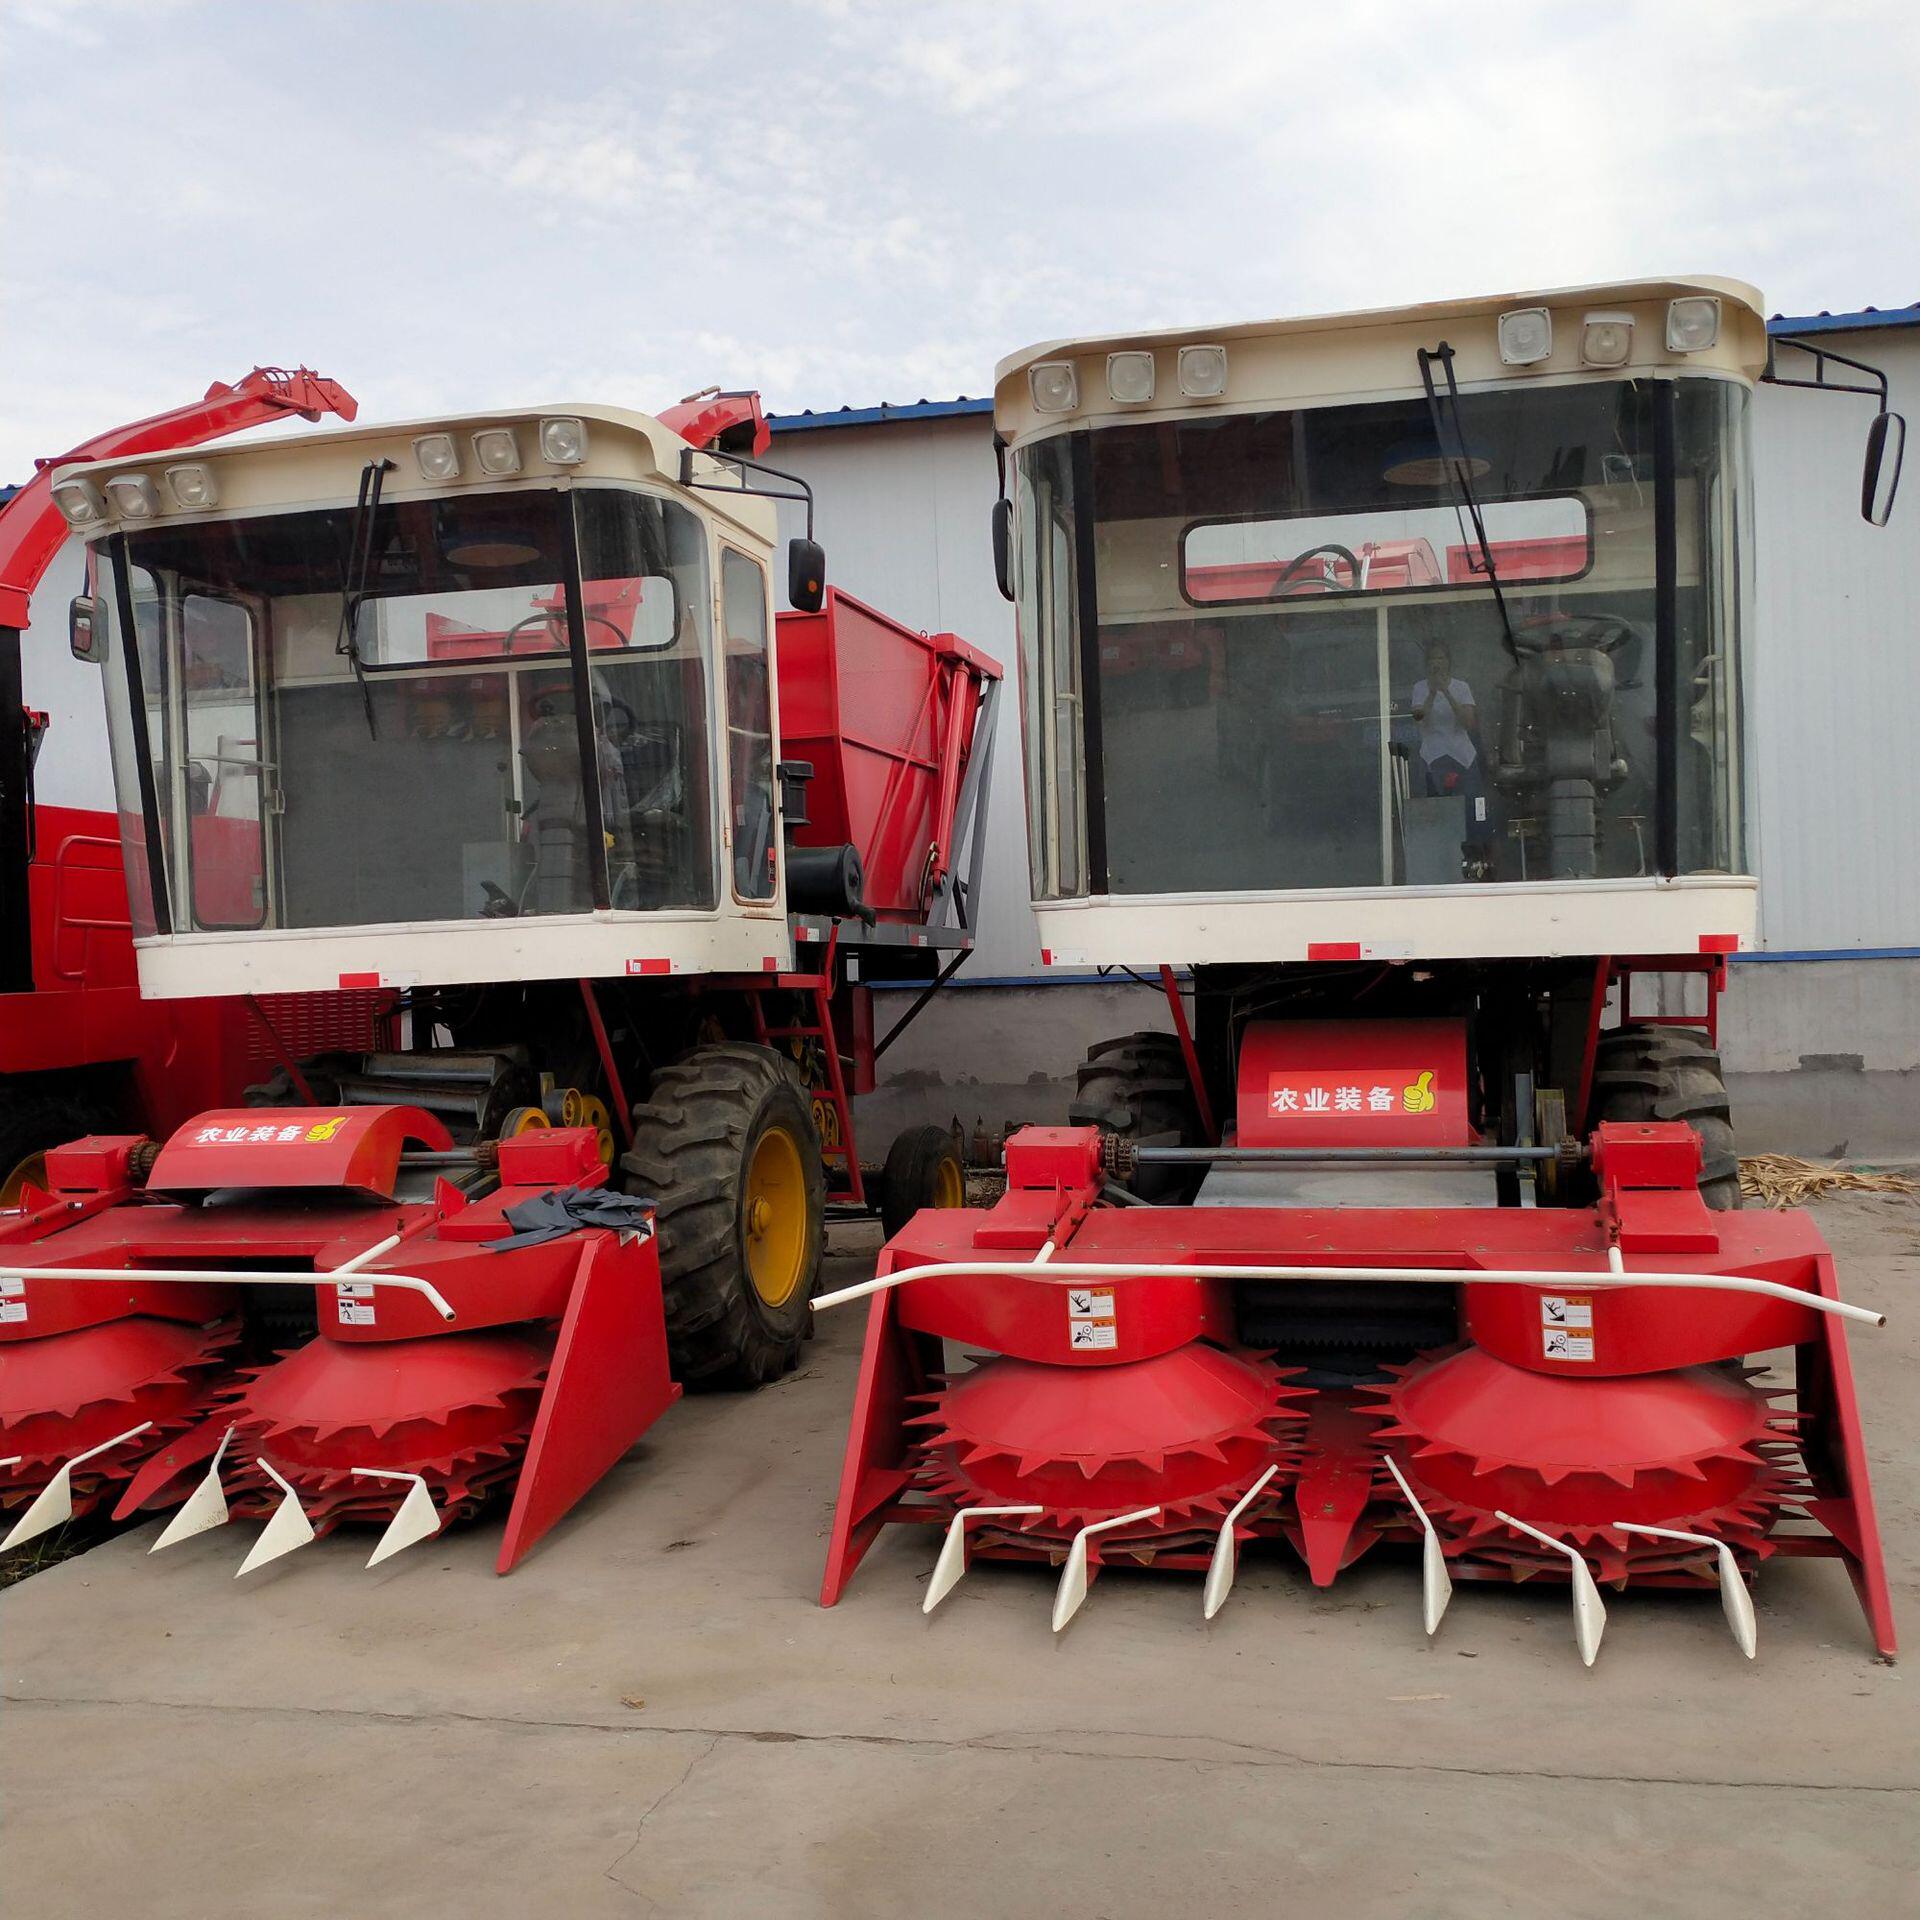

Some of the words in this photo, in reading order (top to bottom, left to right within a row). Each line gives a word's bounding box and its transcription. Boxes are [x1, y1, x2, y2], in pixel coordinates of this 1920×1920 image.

[1271, 1086, 1395, 1113] 农业装备
[195, 1125, 304, 1143] 农业装备
